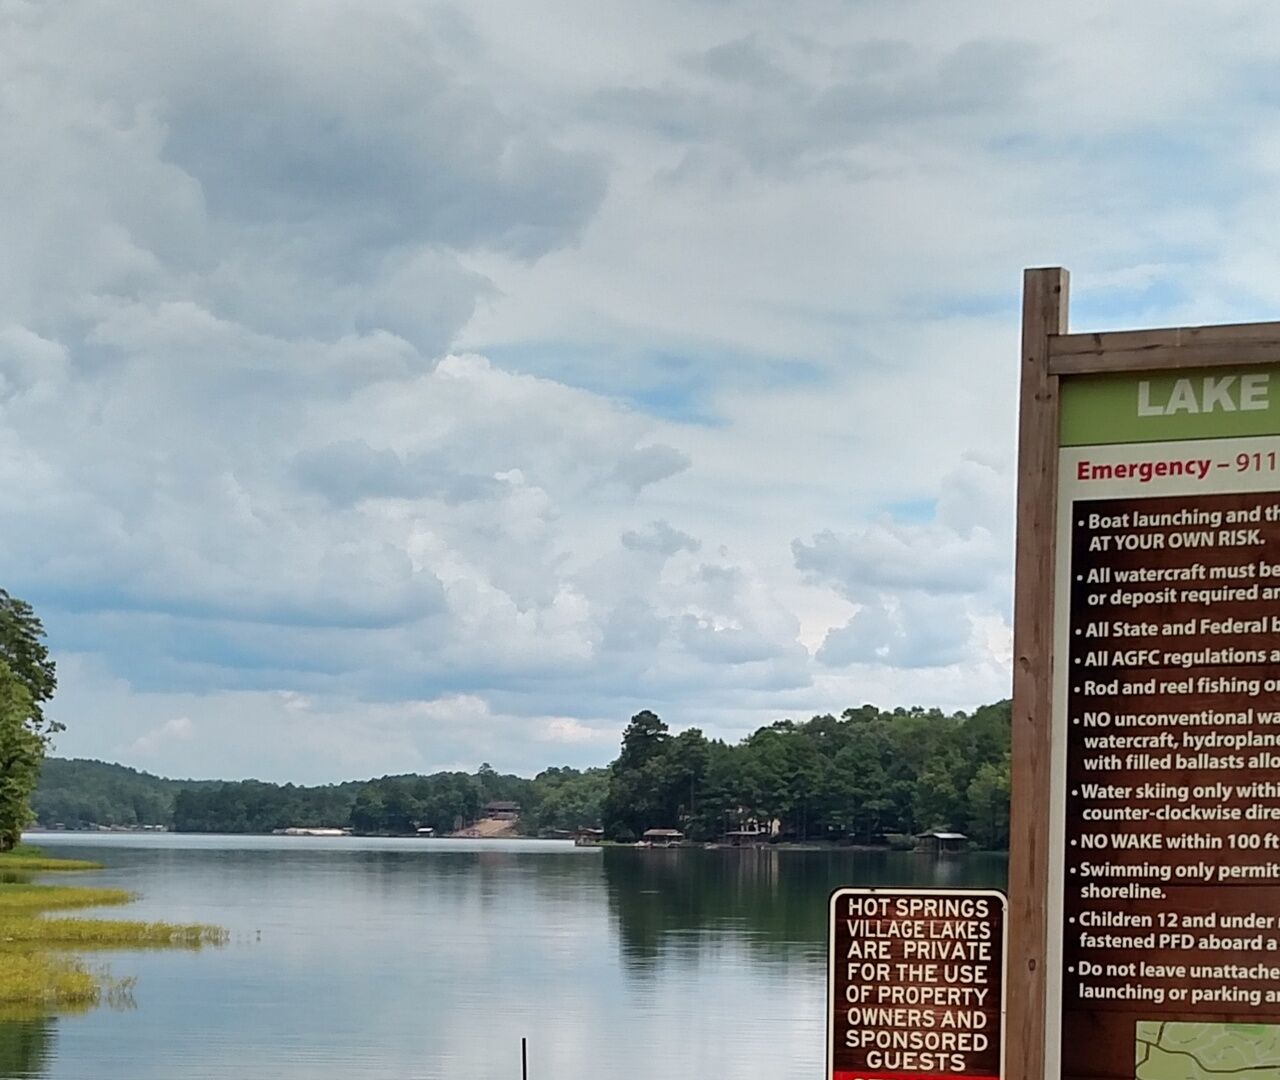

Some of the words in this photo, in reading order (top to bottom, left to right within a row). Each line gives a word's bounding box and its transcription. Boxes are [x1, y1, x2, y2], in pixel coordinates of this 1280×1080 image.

[1137, 375, 1269, 417] LAKE
[1077, 460, 1210, 482] Emergency
[1236, 451, 1278, 473] 911
[1089, 514, 1129, 528] Boat
[1134, 509, 1222, 527] launching
[1226, 506, 1261, 522] and
[1089, 536, 1111, 551] AT
[1115, 534, 1164, 550] YOUR
[1168, 532, 1214, 548] OWN
[1218, 529, 1265, 546] RISK.
[1087, 568, 1110, 583] All
[1114, 564, 1206, 582] watercraft
[1210, 564, 1255, 579] must
[1088, 594, 1106, 605] or
[1110, 588, 1176, 607] deposit
[1181, 584, 1258, 605] required
[1086, 622, 1108, 637] All
[1113, 622, 1158, 636] State
[1162, 619, 1196, 635] and
[1200, 617, 1267, 634] Federal
[1085, 651, 1108, 666] All
[1112, 650, 1160, 665] AGFC
[1164, 648, 1266, 668] regulations
[1085, 680, 1118, 695] Rod
[1122, 679, 1155, 694] and
[1160, 678, 1193, 693] reel
[1198, 677, 1260, 696] fishing
[1084, 712, 1110, 726] NO
[1115, 709, 1253, 726] unconventional
[1084, 732, 1178, 749] watercraft,
[1084, 755, 1121, 770] with
[1126, 754, 1171, 769] filled
[1176, 754, 1244, 769] ballasts
[1082, 784, 1132, 798] Water
[1136, 783, 1188, 802] skiing
[1193, 782, 1232, 801] only
[1083, 804, 1241, 820] counter-clockwise
[1082, 834, 1108, 848] NO
[1111, 834, 1162, 848] WAKE
[1166, 834, 1222, 848] within
[1228, 834, 1260, 848] 100
[1264, 833, 1279, 848] ft
[1081, 862, 1171, 880] Swimming
[1176, 862, 1214, 880] only
[1081, 883, 1166, 898] shoreline.
[849, 898, 890, 916] HOT
[896, 899, 988, 917] SPRINGS
[847, 920, 924, 937] VILLAGE
[930, 921, 991, 939] LAKES
[1080, 911, 1152, 926] Children
[1158, 913, 1177, 927] 12
[1182, 912, 1216, 927] and
[1221, 913, 1274, 928] under
[848, 941, 891, 959] ARE
[904, 940, 991, 960] PRIVATE
[1080, 932, 1154, 948] fastened
[1160, 934, 1194, 948] PFD
[1199, 934, 1262, 950] aboard
[1267, 939, 1277, 950] a
[848, 963, 890, 981] FOR
[896, 964, 938, 982] THE
[945, 965, 987, 983] USE
[1079, 961, 1102, 975] Do
[1107, 964, 1136, 976] not
[1140, 962, 1186, 977] leave
[846, 985, 873, 1002] OF
[879, 986, 988, 1006] PROPERTY
[1080, 983, 1164, 1003] launching
[1169, 989, 1188, 1000] or
[1192, 986, 1261, 1006] parking
[848, 1008, 935, 1027] OWNERS
[941, 1011, 987, 1029] AND
[846, 1030, 988, 1051] SPONSORED
[867, 1051, 965, 1071] GUESTS
